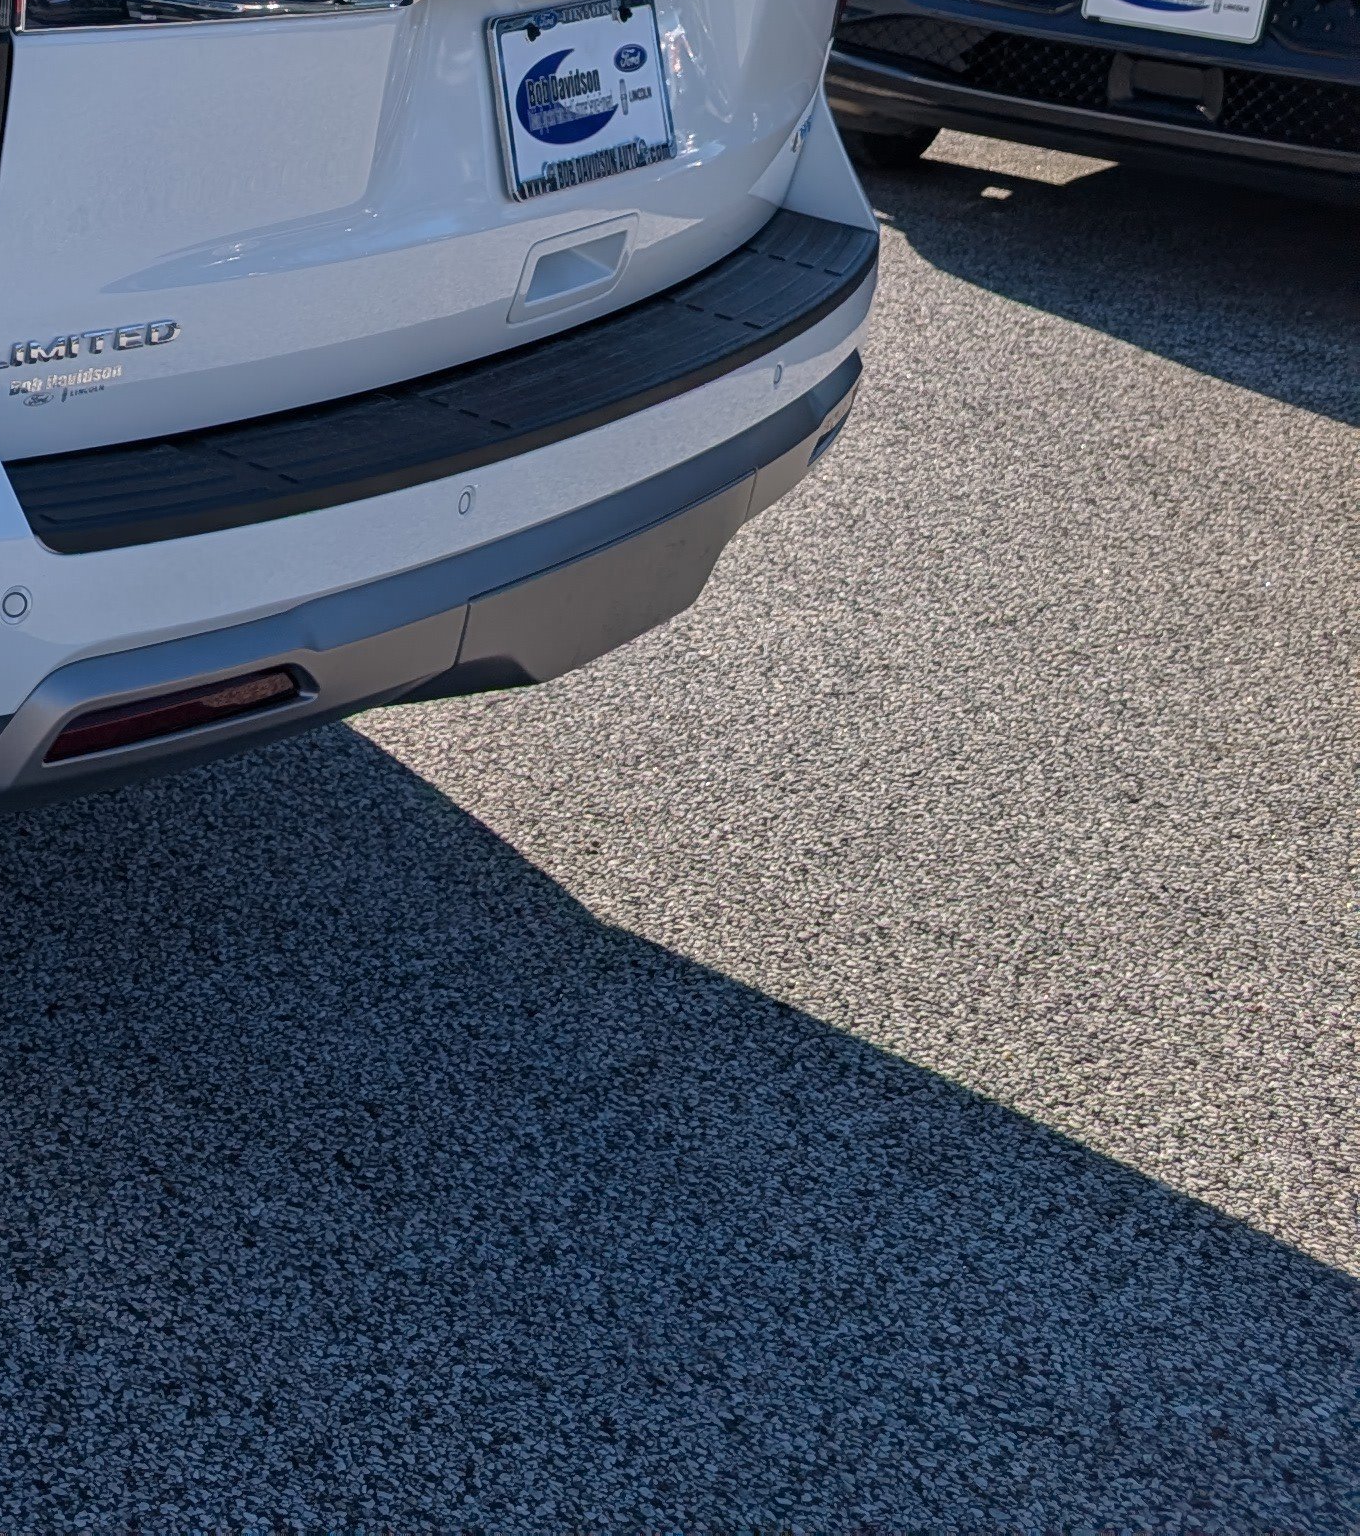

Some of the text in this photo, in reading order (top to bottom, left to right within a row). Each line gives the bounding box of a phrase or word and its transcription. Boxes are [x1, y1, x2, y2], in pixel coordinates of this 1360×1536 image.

[526, 68, 601, 107] Bob Davidson
[9, 365, 122, 396] Bob Davidson
